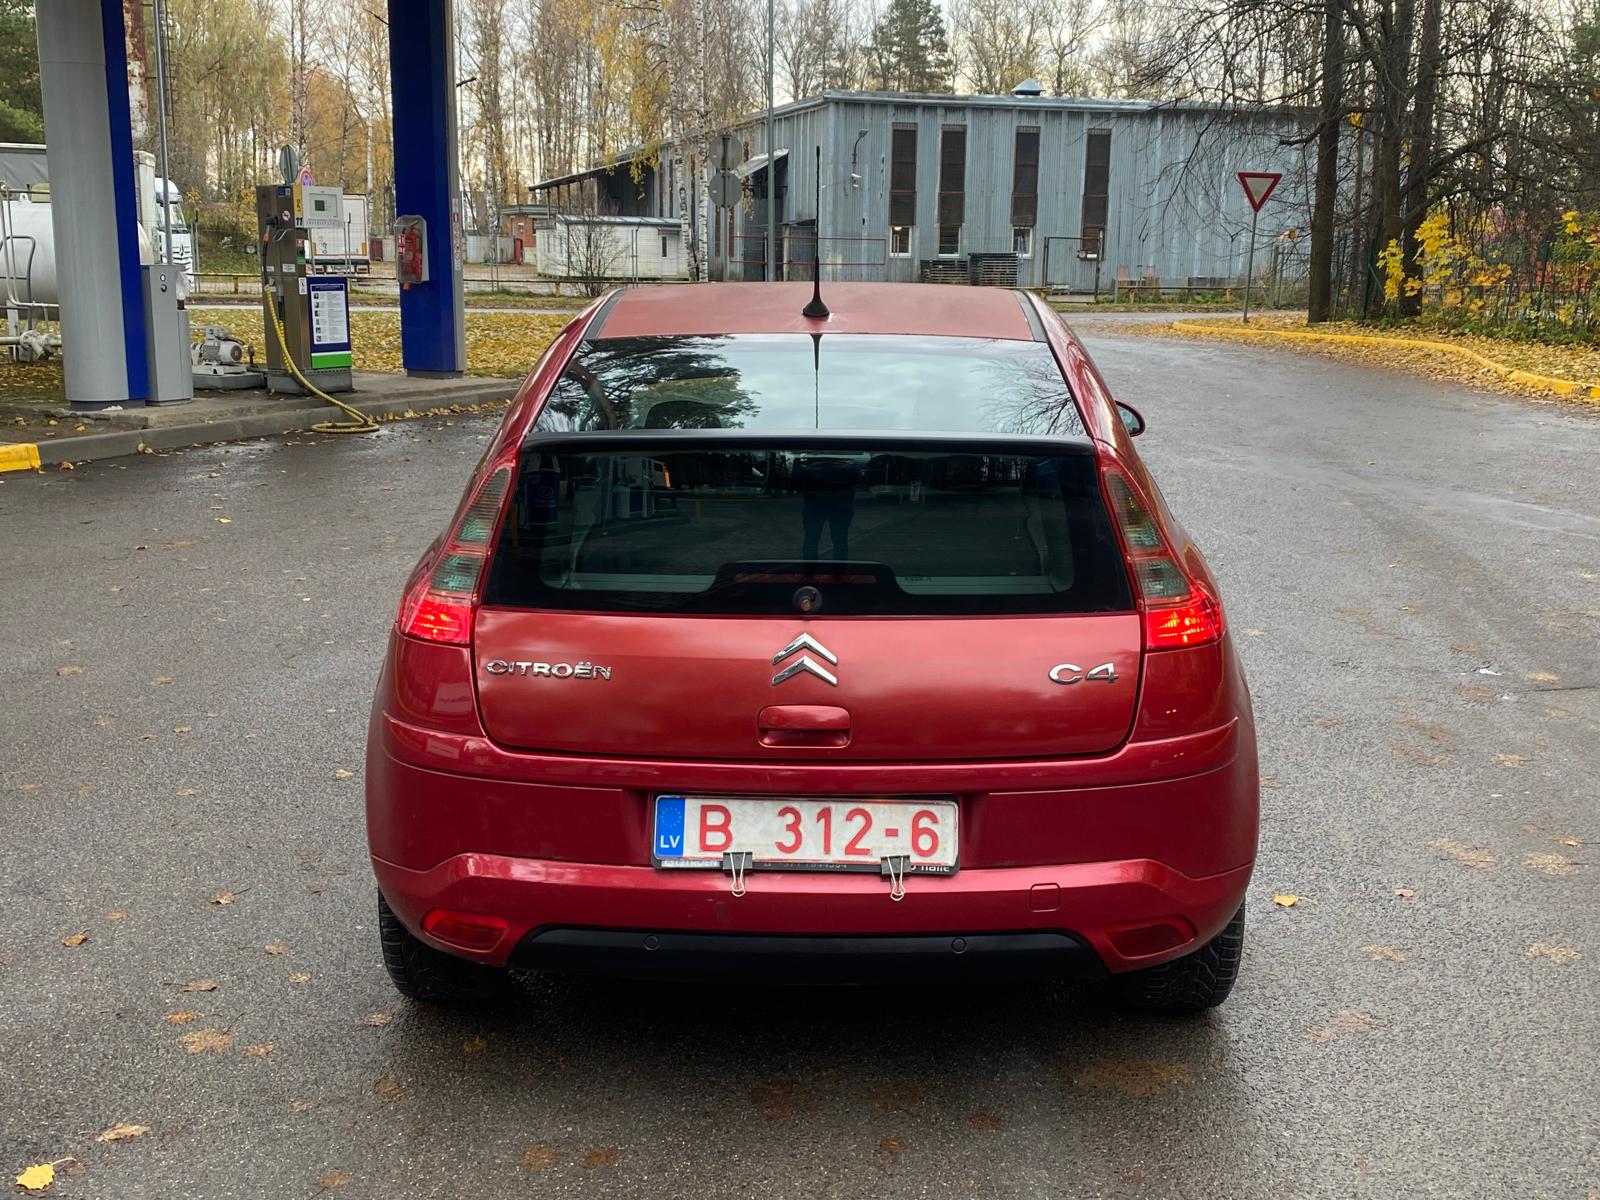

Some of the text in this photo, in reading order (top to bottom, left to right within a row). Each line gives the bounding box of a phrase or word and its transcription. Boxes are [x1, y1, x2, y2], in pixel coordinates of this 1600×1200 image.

[486, 659, 612, 681] CITROËN
[660, 835, 680, 849] LV
[699, 804, 939, 858] B 312-6
